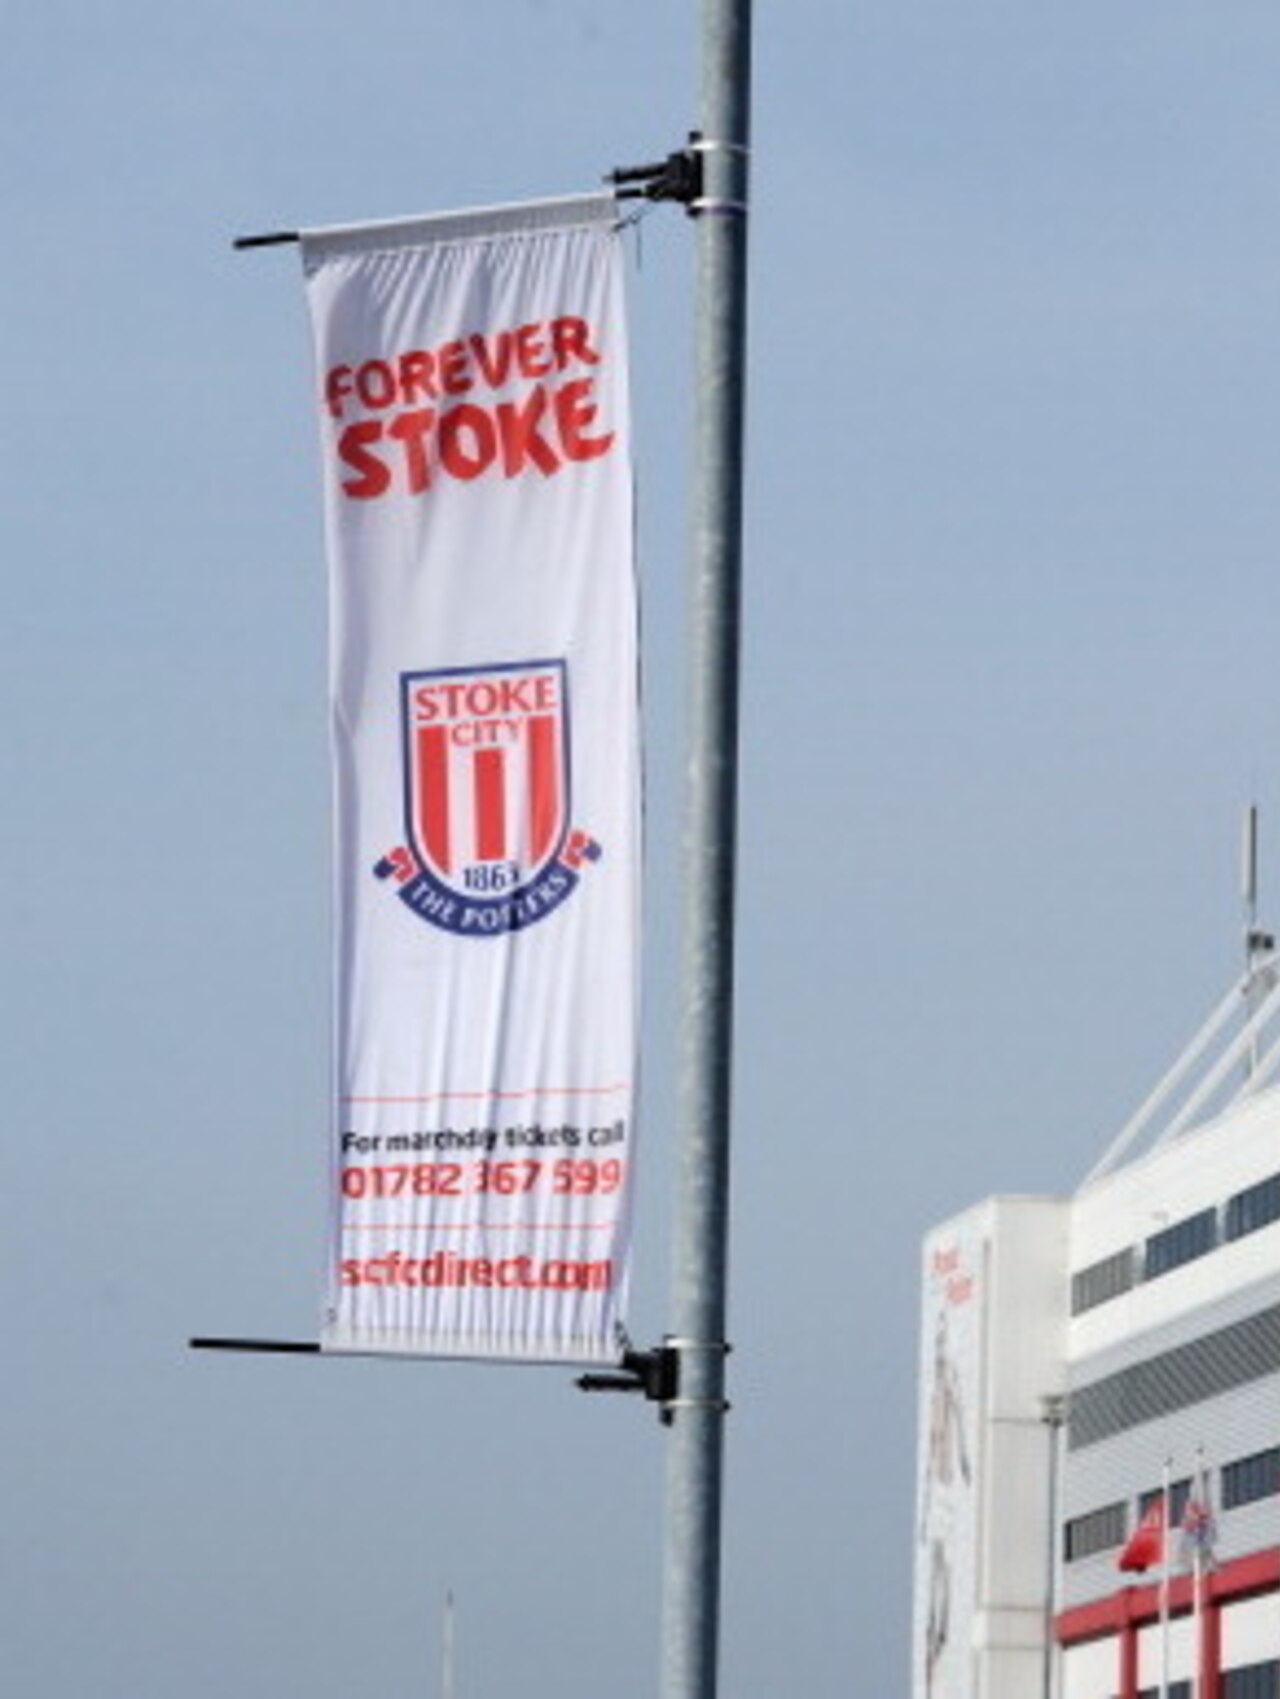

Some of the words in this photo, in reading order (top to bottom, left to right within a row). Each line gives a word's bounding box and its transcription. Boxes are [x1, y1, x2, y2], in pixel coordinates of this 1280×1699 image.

[325, 316, 598, 418] FOREVER
[338, 378, 615, 500] STOKE
[414, 675, 558, 722] STOKE
[451, 717, 521, 746] CITY
[411, 881, 456, 922] THE
[341, 1132, 380, 1154] For
[505, 1123, 580, 1148] tickets
[588, 1120, 625, 1146] call
[341, 1161, 462, 1198] 01782
[475, 1159, 543, 1194] 367
[552, 1157, 623, 1194] 599
[339, 1251, 613, 1291] scfcdirect.com
